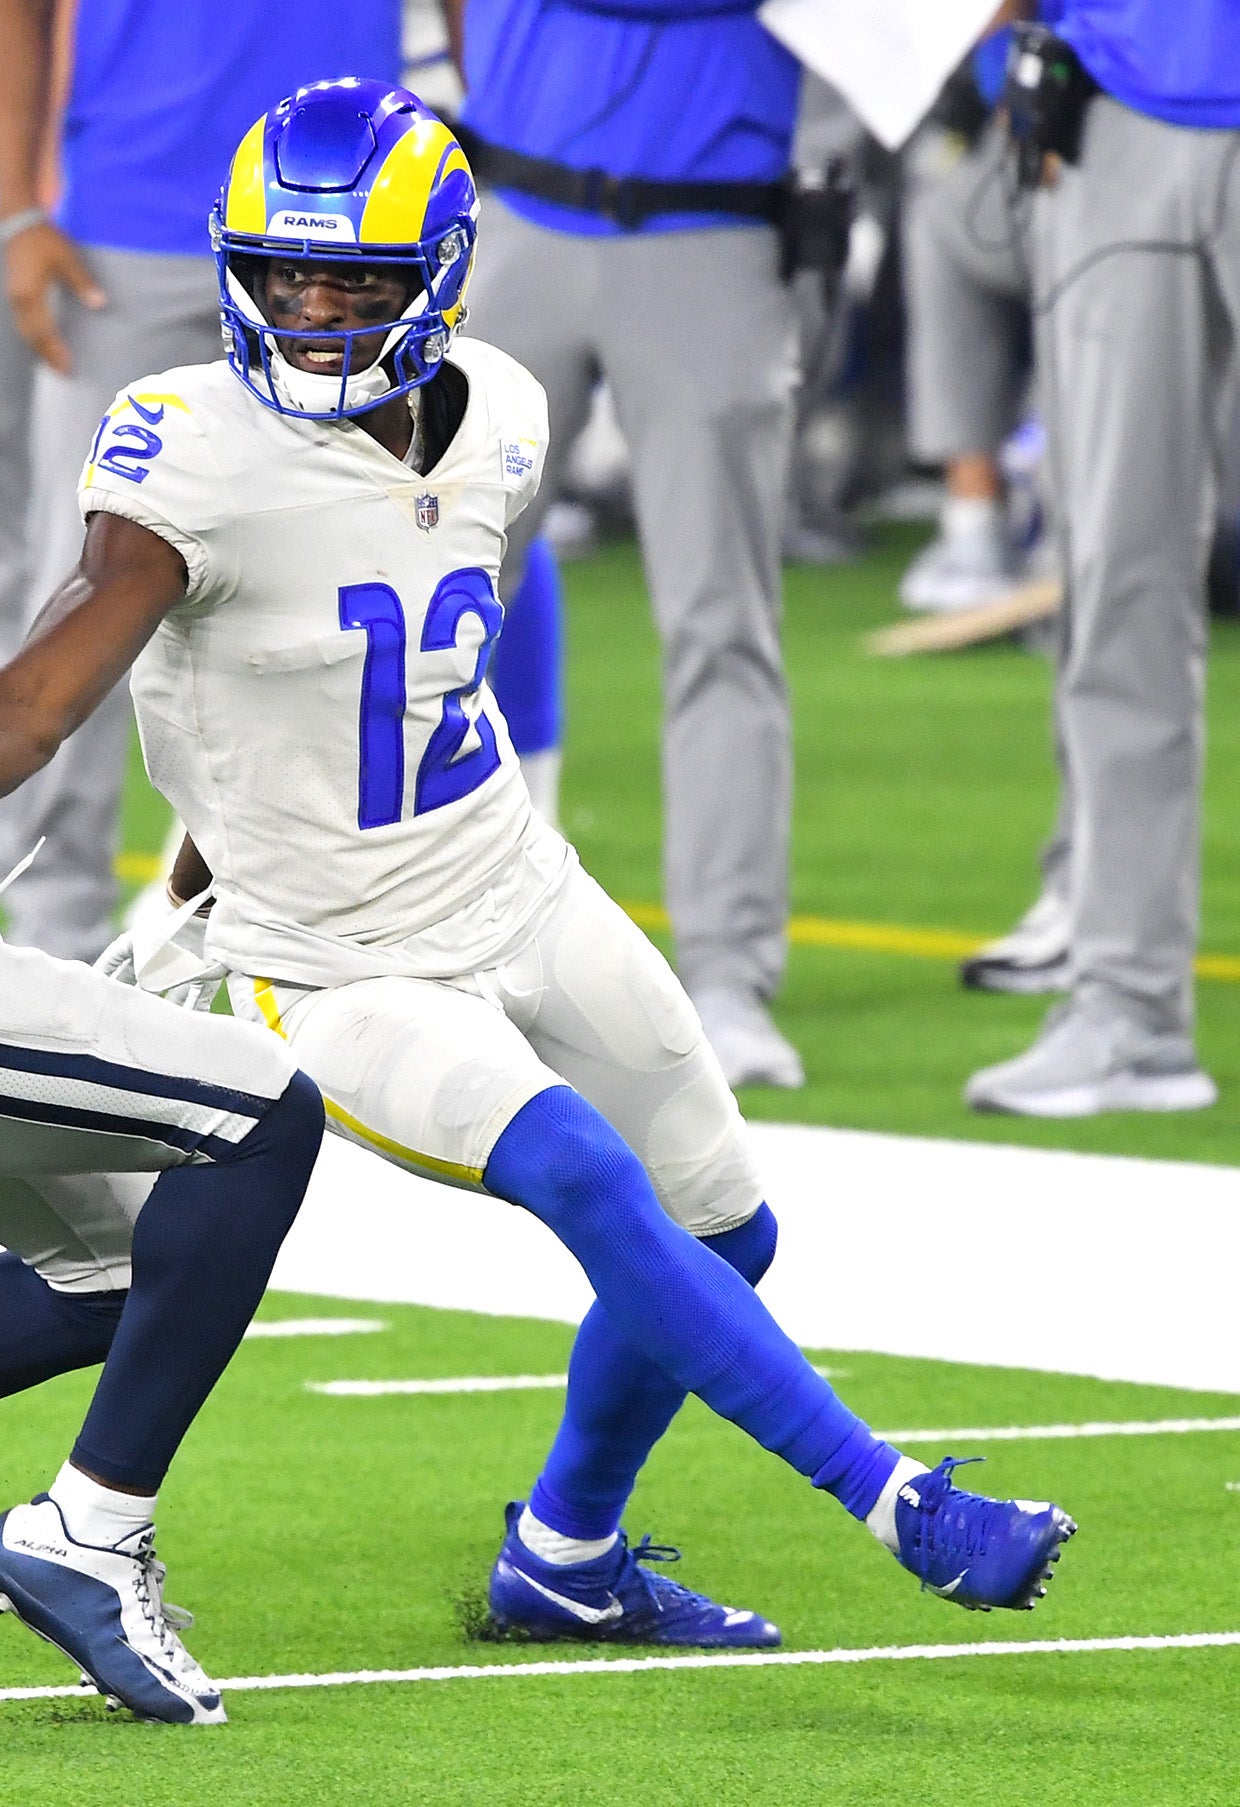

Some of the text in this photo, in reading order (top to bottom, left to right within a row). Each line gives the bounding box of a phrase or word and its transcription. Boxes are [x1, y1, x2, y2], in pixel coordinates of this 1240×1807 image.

[284, 215, 338, 230] RAMS
[89, 415, 163, 484] 12
[503, 444, 520, 455] LOS
[338, 566, 506, 831] 12
